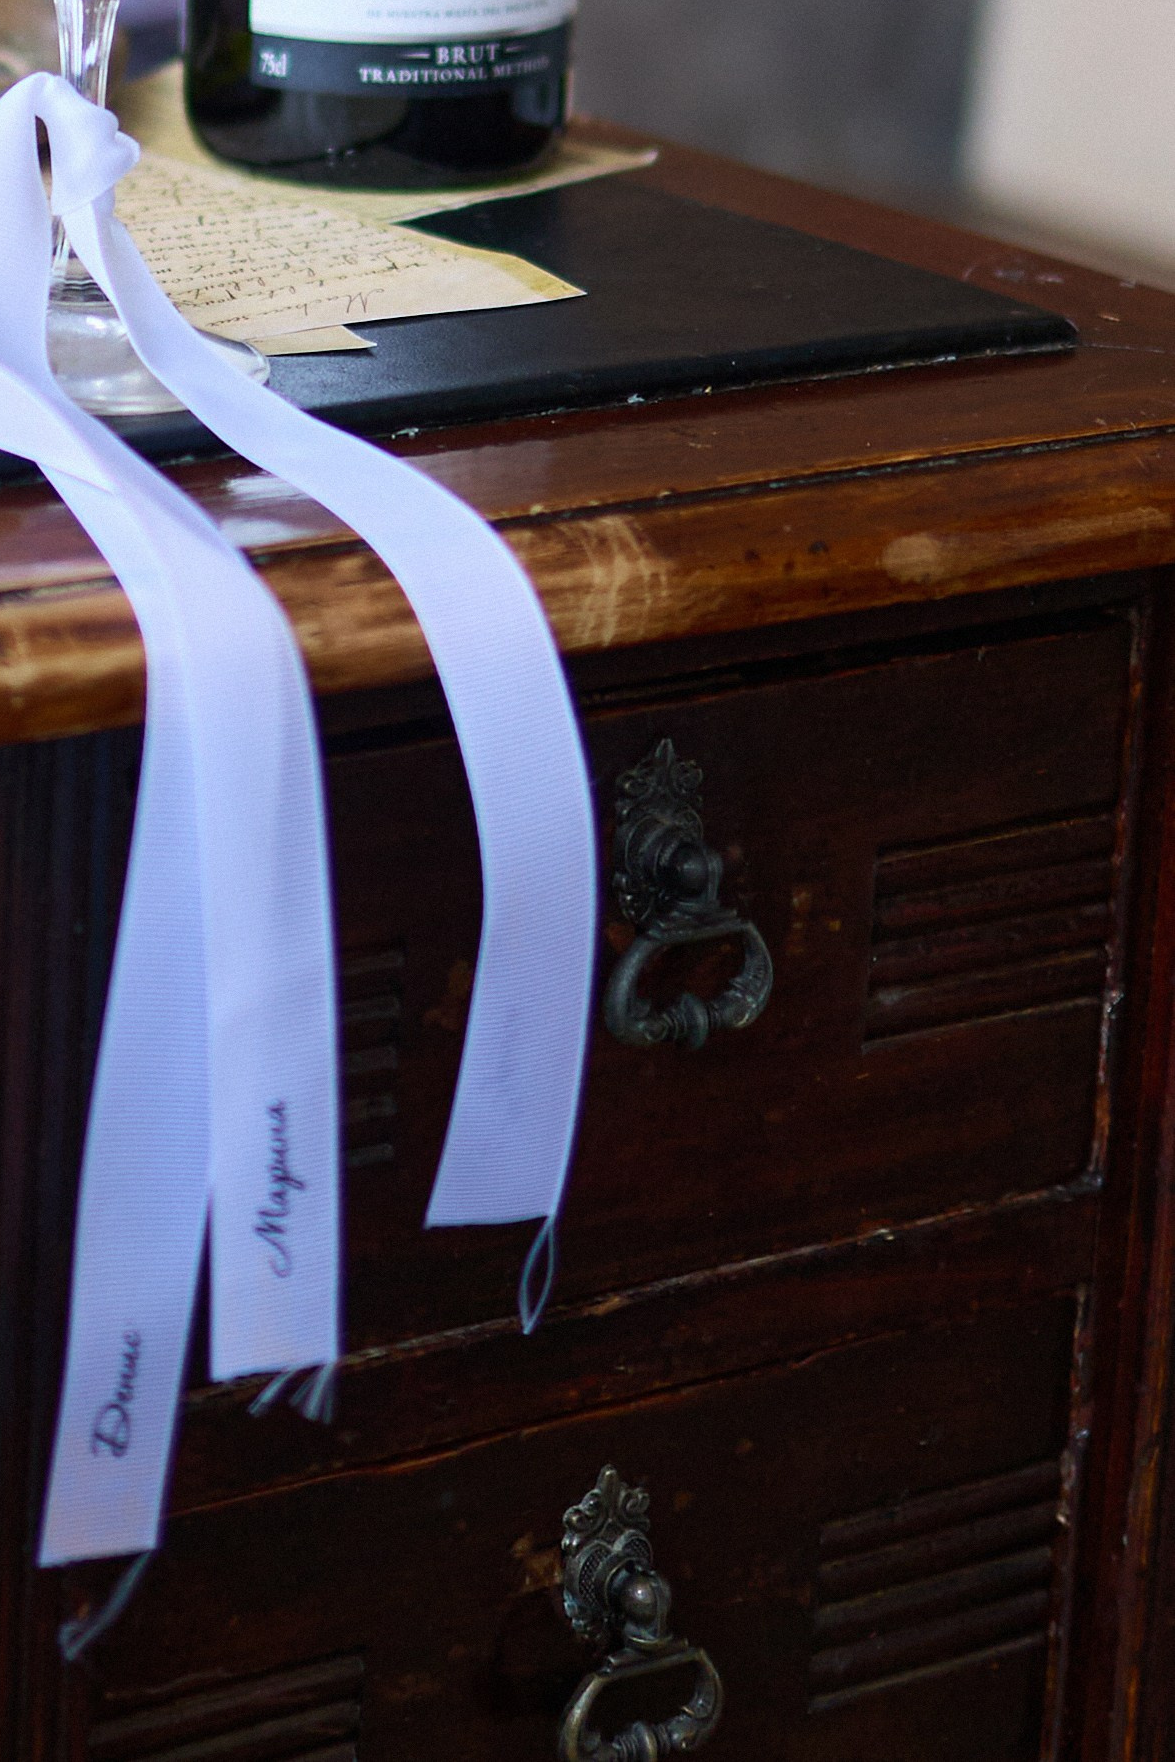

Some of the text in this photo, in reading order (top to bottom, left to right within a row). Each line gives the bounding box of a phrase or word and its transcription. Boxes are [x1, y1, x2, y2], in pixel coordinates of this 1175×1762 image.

[359, 66, 487, 84] TRADITIONAL
[435, 43, 500, 66] BRUT
[253, 1099, 306, 1279] Марина
[91, 1330, 142, 1458] Денис
